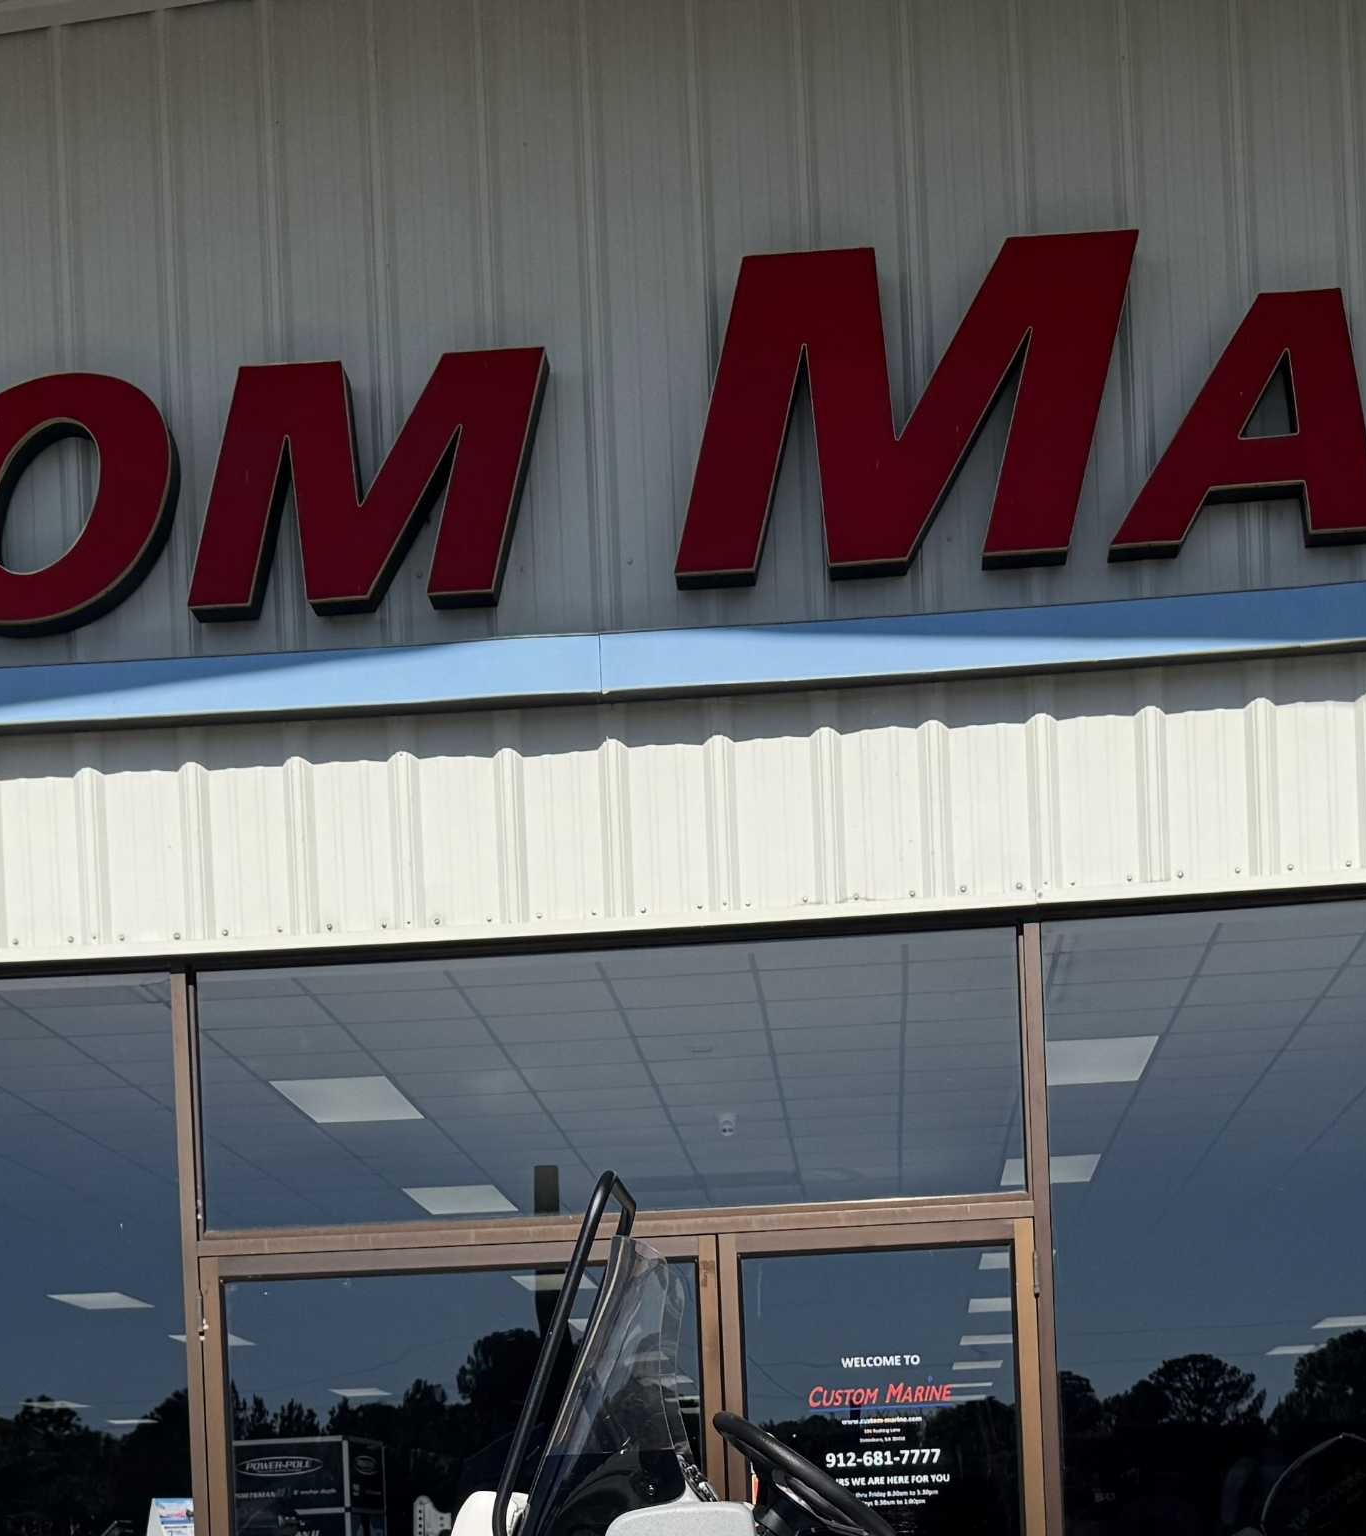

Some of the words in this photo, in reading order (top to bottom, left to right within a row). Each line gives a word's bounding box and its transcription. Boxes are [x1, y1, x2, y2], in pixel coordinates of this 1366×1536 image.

[841, 1356, 901, 1368] WELCOME
[903, 1354, 920, 1366] TO
[809, 1386, 879, 1408] CUSTOM
[885, 1382, 954, 1403] MARINE
[825, 1449, 941, 1468] 912-681-7777
[851, 1476, 866, 1486] WE
[867, 1476, 885, 1486] ARE
[886, 1475, 910, 1485] HERE
[911, 1474, 930, 1484] FOR
[930, 1473, 950, 1483] YOU
